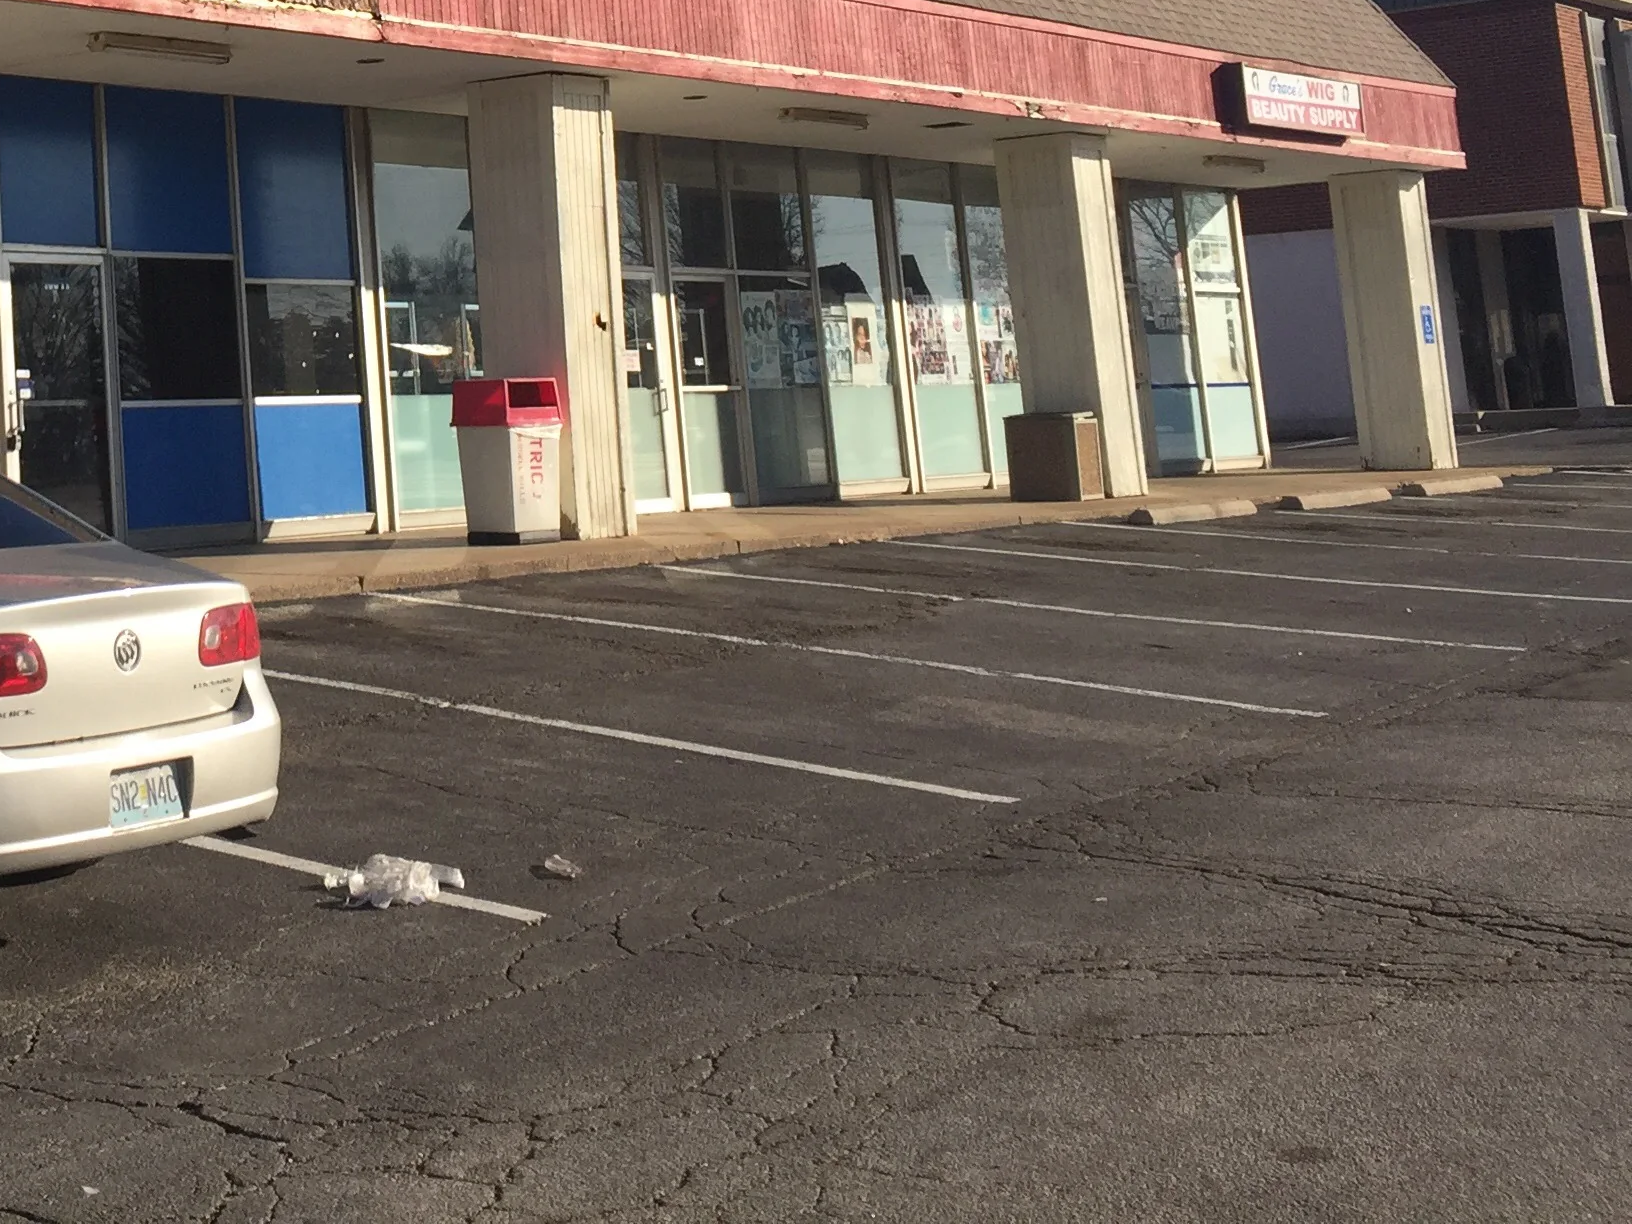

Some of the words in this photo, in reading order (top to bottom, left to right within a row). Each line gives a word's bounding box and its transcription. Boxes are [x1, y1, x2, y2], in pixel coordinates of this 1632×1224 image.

[1306, 81, 1336, 102] WIG
[1251, 99, 1306, 125] BEAUTY
[1309, 108, 1358, 129] SUPPLY
[111, 780, 141, 814] SN2
